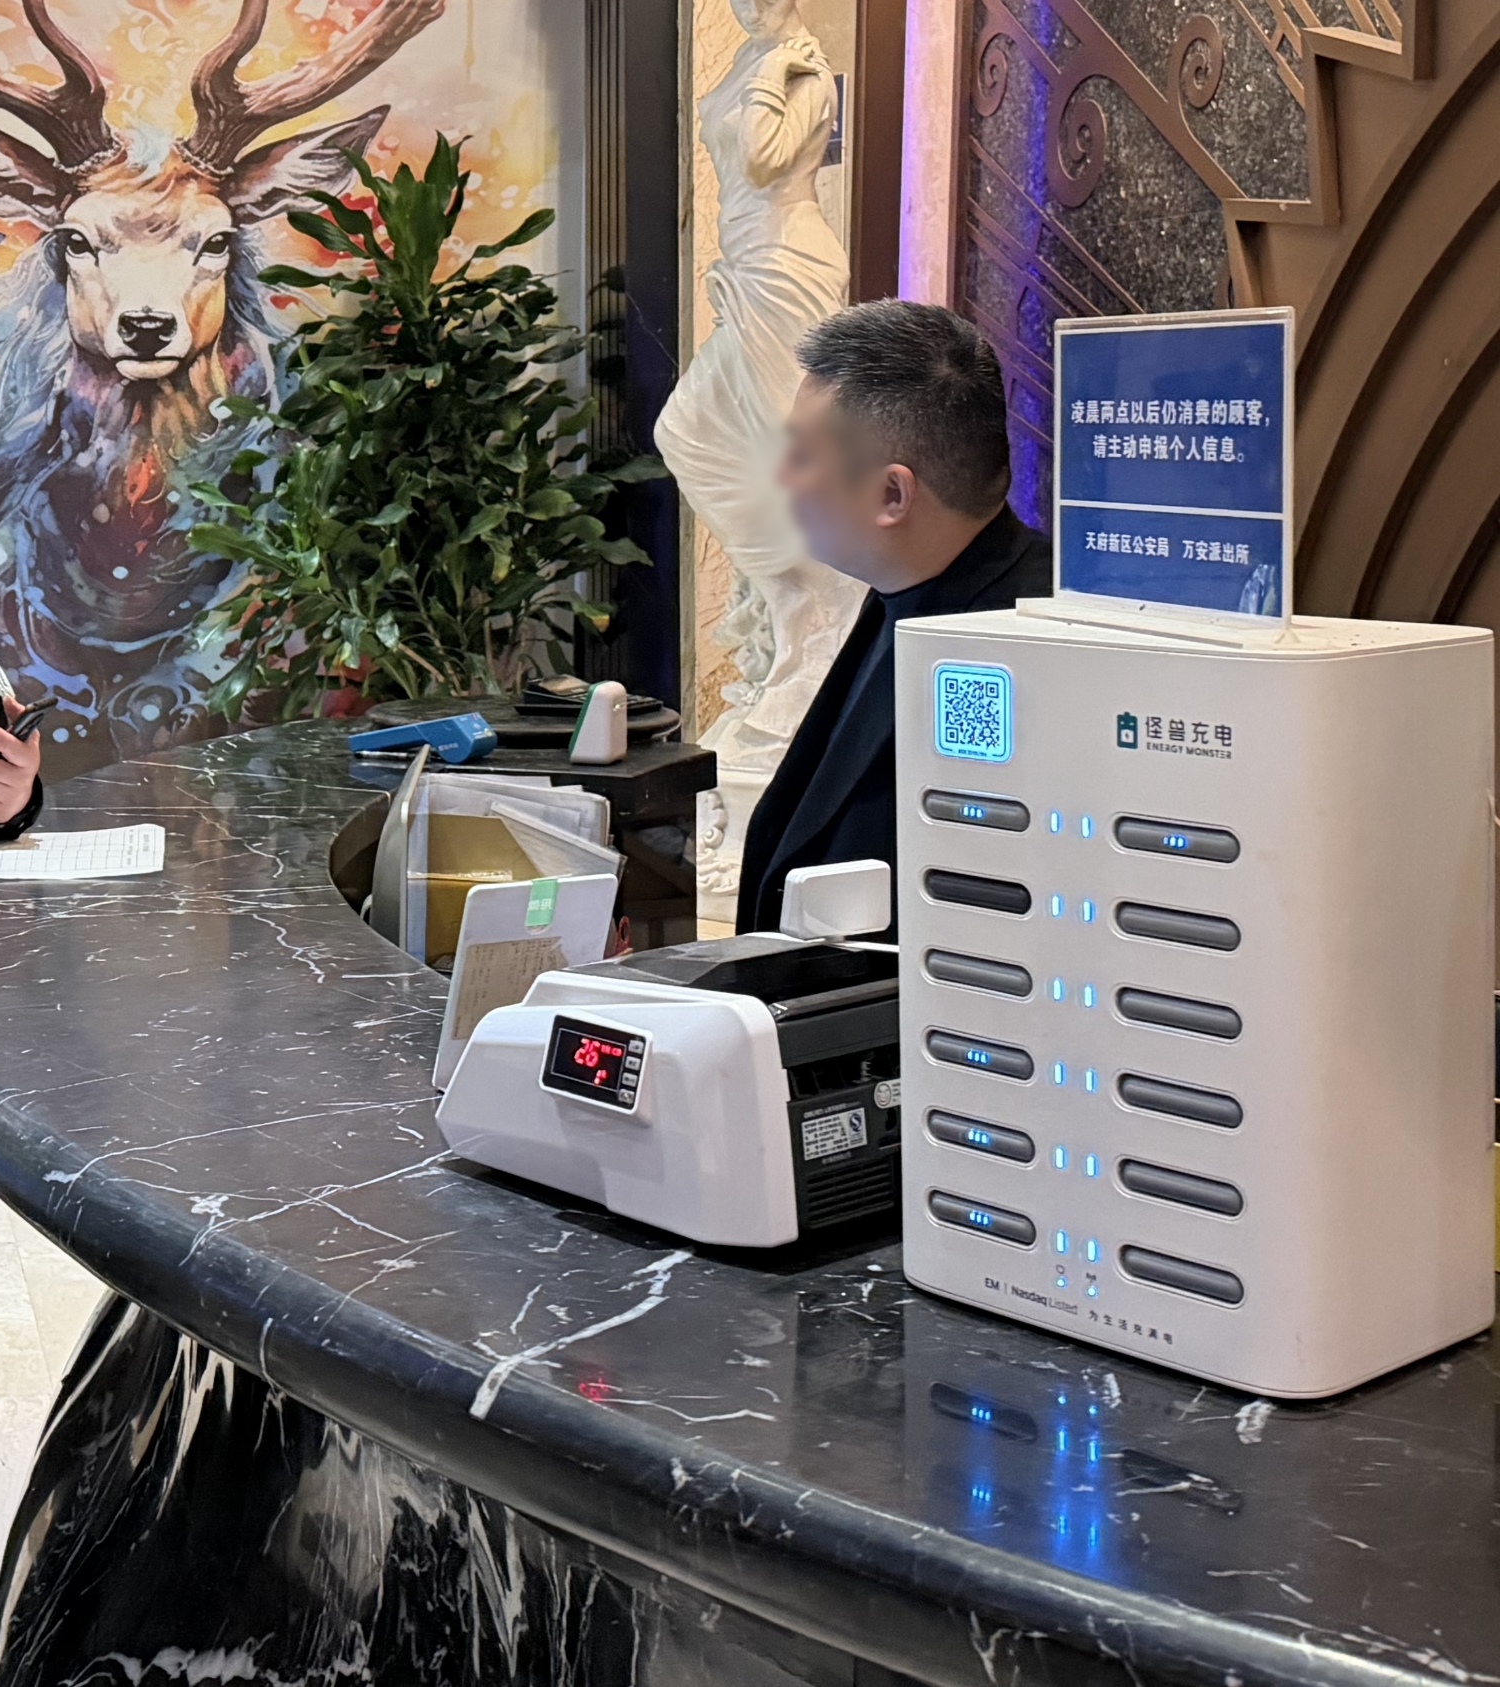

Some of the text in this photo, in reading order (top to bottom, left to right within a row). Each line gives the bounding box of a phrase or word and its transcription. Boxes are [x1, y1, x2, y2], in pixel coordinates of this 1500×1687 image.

[1093, 434, 1245, 463] 请主动申报个人信息。
[1085, 531, 1249, 565] 天府新区公安局 万安派出所
[1145, 716, 1232, 747] 怪兽充电
[1146, 742, 1232, 759] ENERGY MONSTER
[985, 1277, 1000, 1291] EM
[1011, 1285, 1048, 1307] Nasdaq
